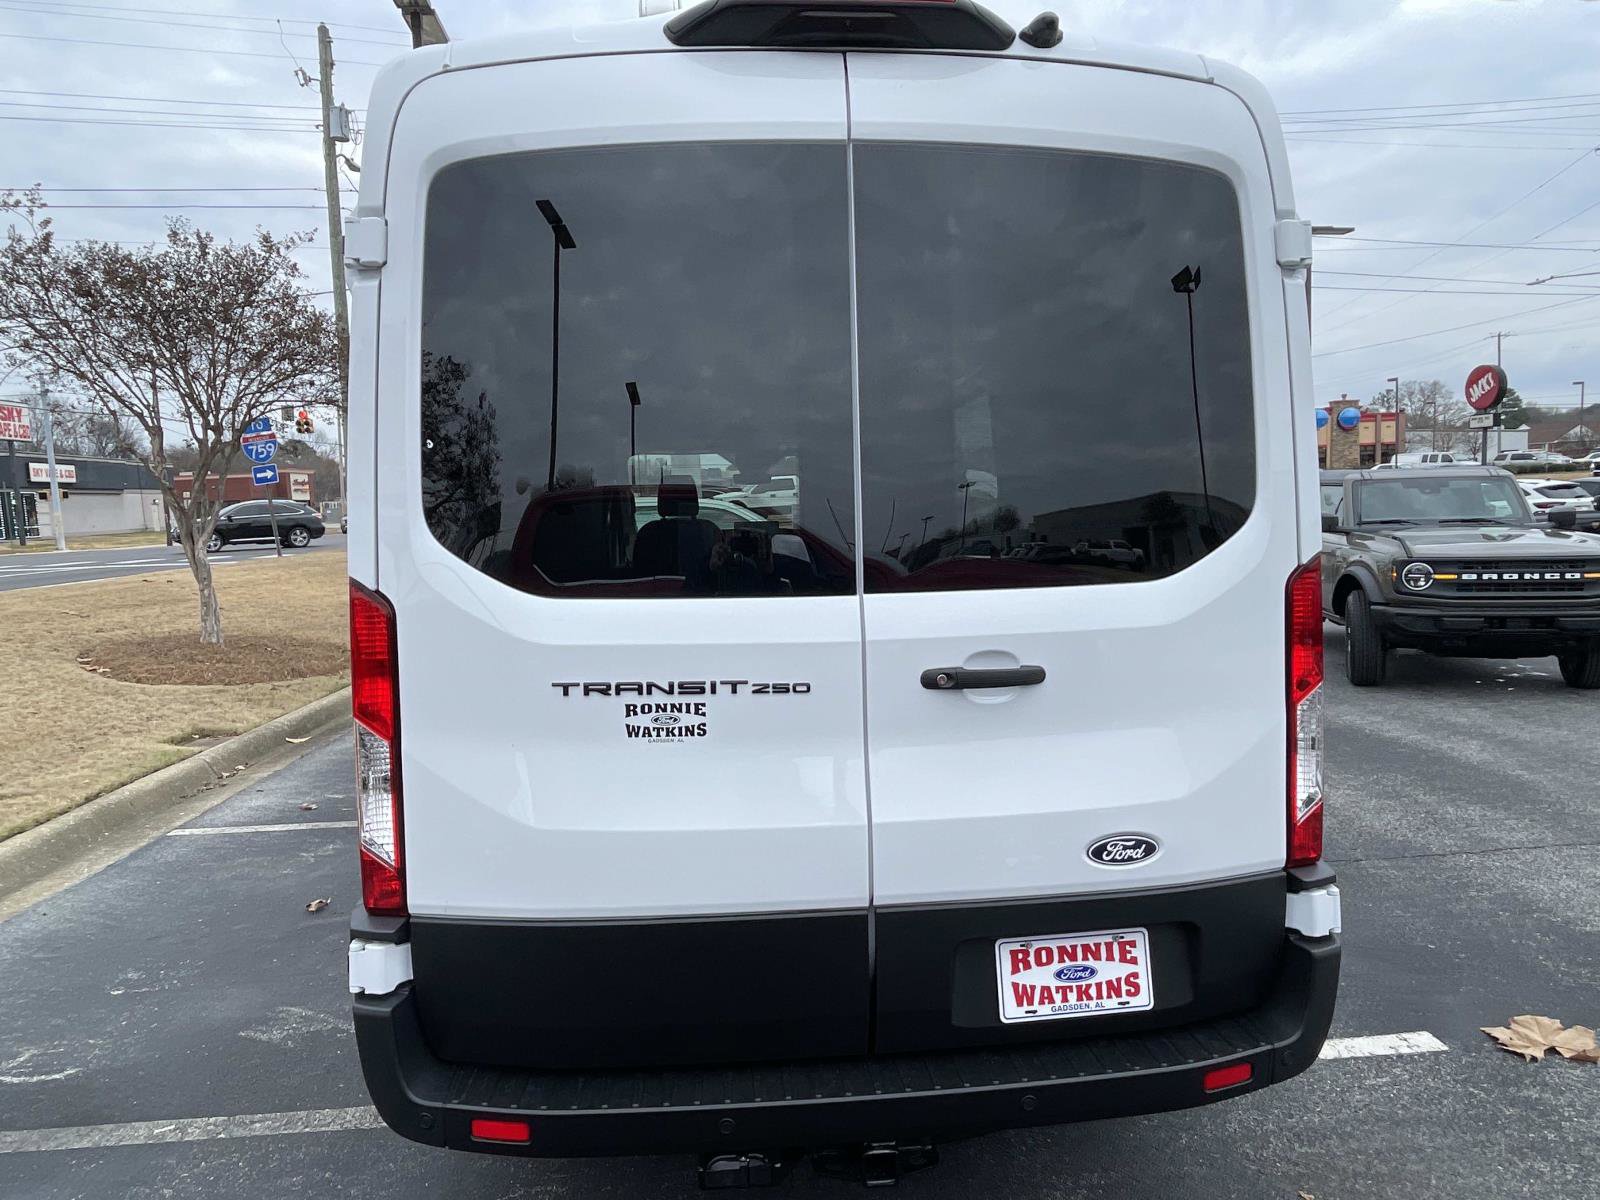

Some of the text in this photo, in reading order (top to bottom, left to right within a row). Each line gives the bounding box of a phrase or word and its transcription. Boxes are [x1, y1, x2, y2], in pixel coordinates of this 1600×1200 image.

[248, 443, 275, 459] 759
[552, 680, 811, 697] TRANSIT 250
[625, 702, 707, 718] RONNIE
[625, 722, 707, 738] WATKINS
[1102, 840, 1146, 861] Ford
[1009, 939, 1139, 976] RONNIE
[1011, 971, 1141, 1008] WATKINS
[1051, 1001, 1106, 1013] GADSDEN, AL
